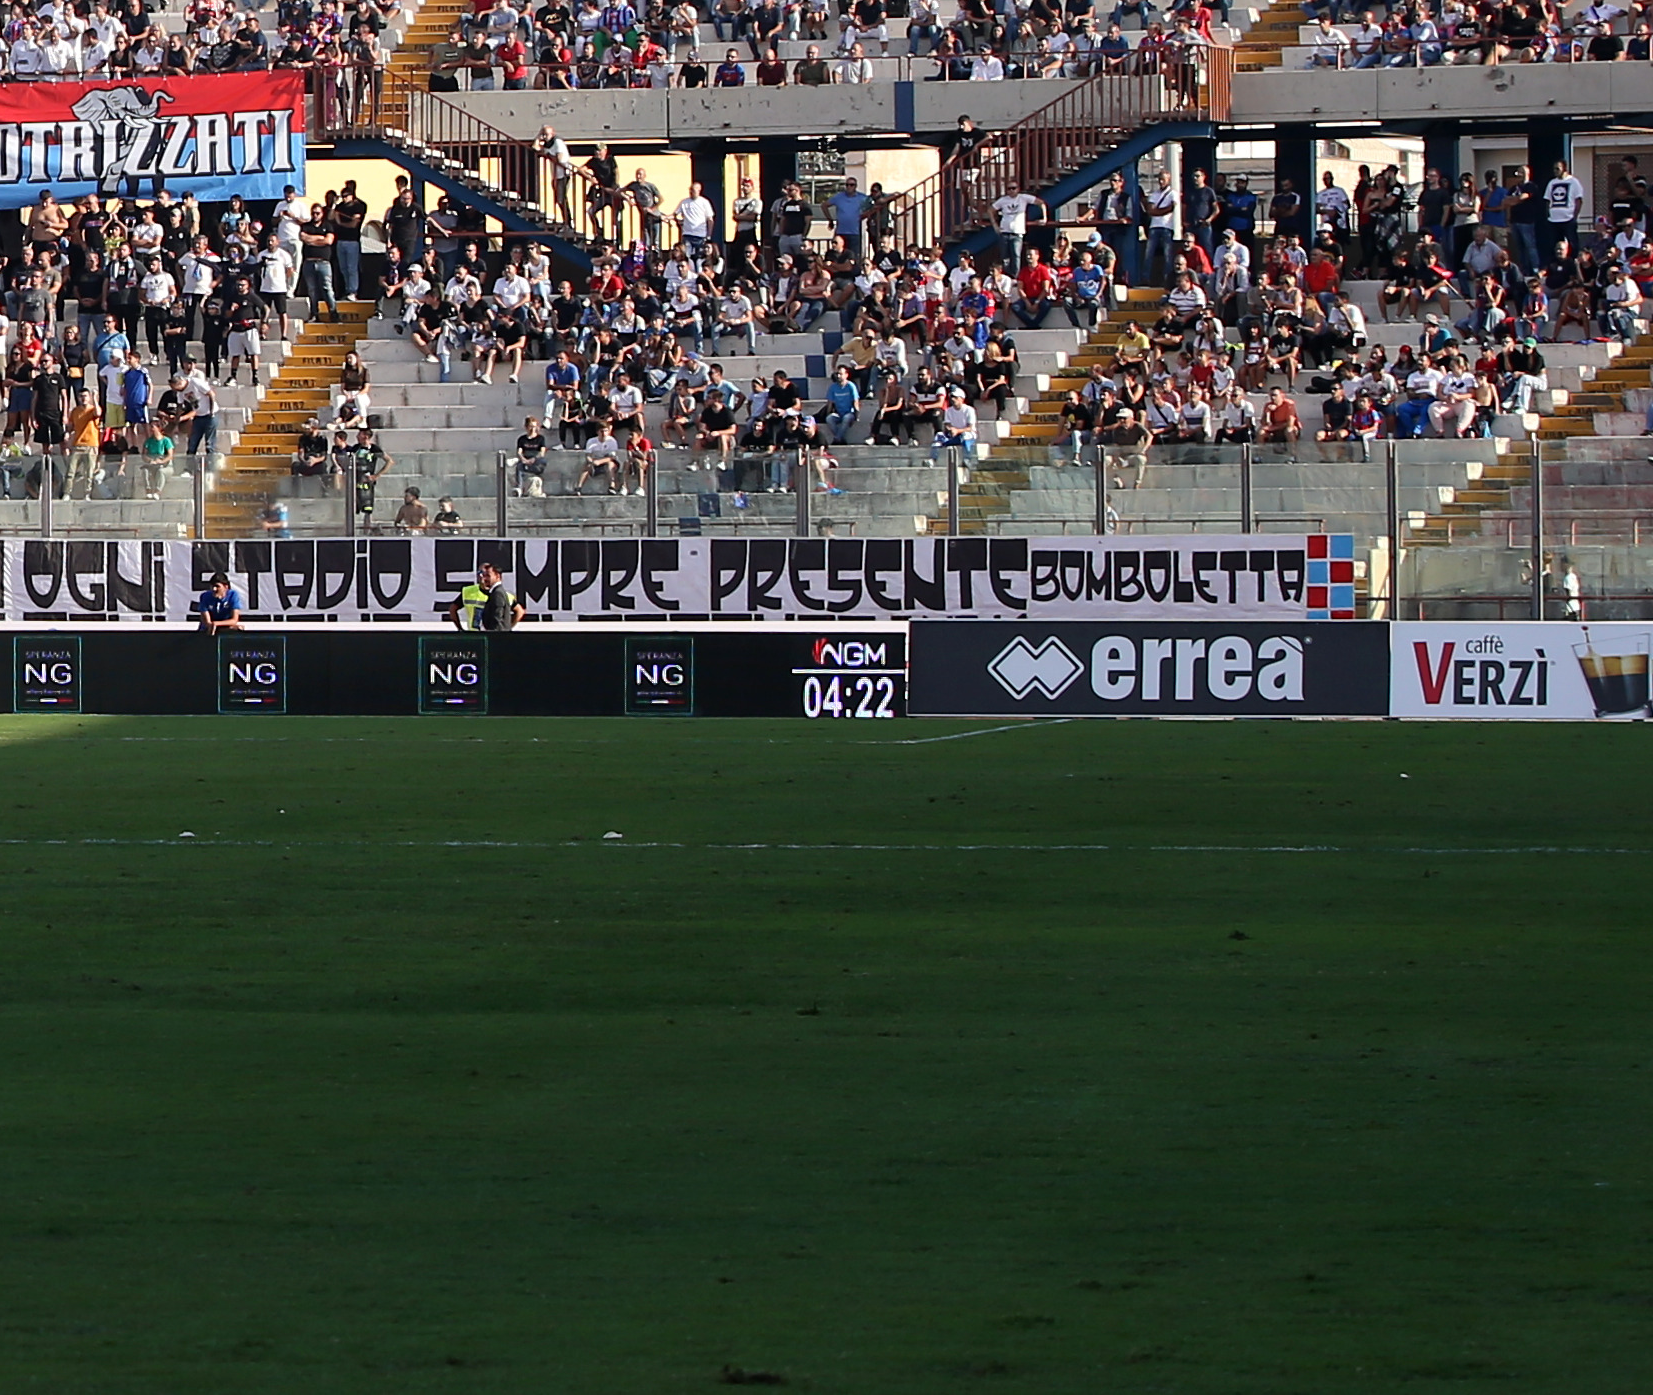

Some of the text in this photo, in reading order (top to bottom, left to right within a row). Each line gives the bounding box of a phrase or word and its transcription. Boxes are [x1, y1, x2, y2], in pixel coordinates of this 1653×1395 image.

[23, 540, 166, 613] OGNI
[192, 540, 413, 612] STADIO
[710, 538, 1029, 612] PRESENTE
[1030, 550, 1306, 604] BOMBOLETTA
[1465, 634, 1505, 654] caffè
[24, 663, 73, 685] NG
[228, 663, 277, 685] NG
[429, 663, 479, 685] NG
[636, 664, 684, 686] NG
[1090, 635, 1306, 702] errea
[1412, 641, 1548, 706] VERZÌ
[802, 676, 894, 719] 04:22
